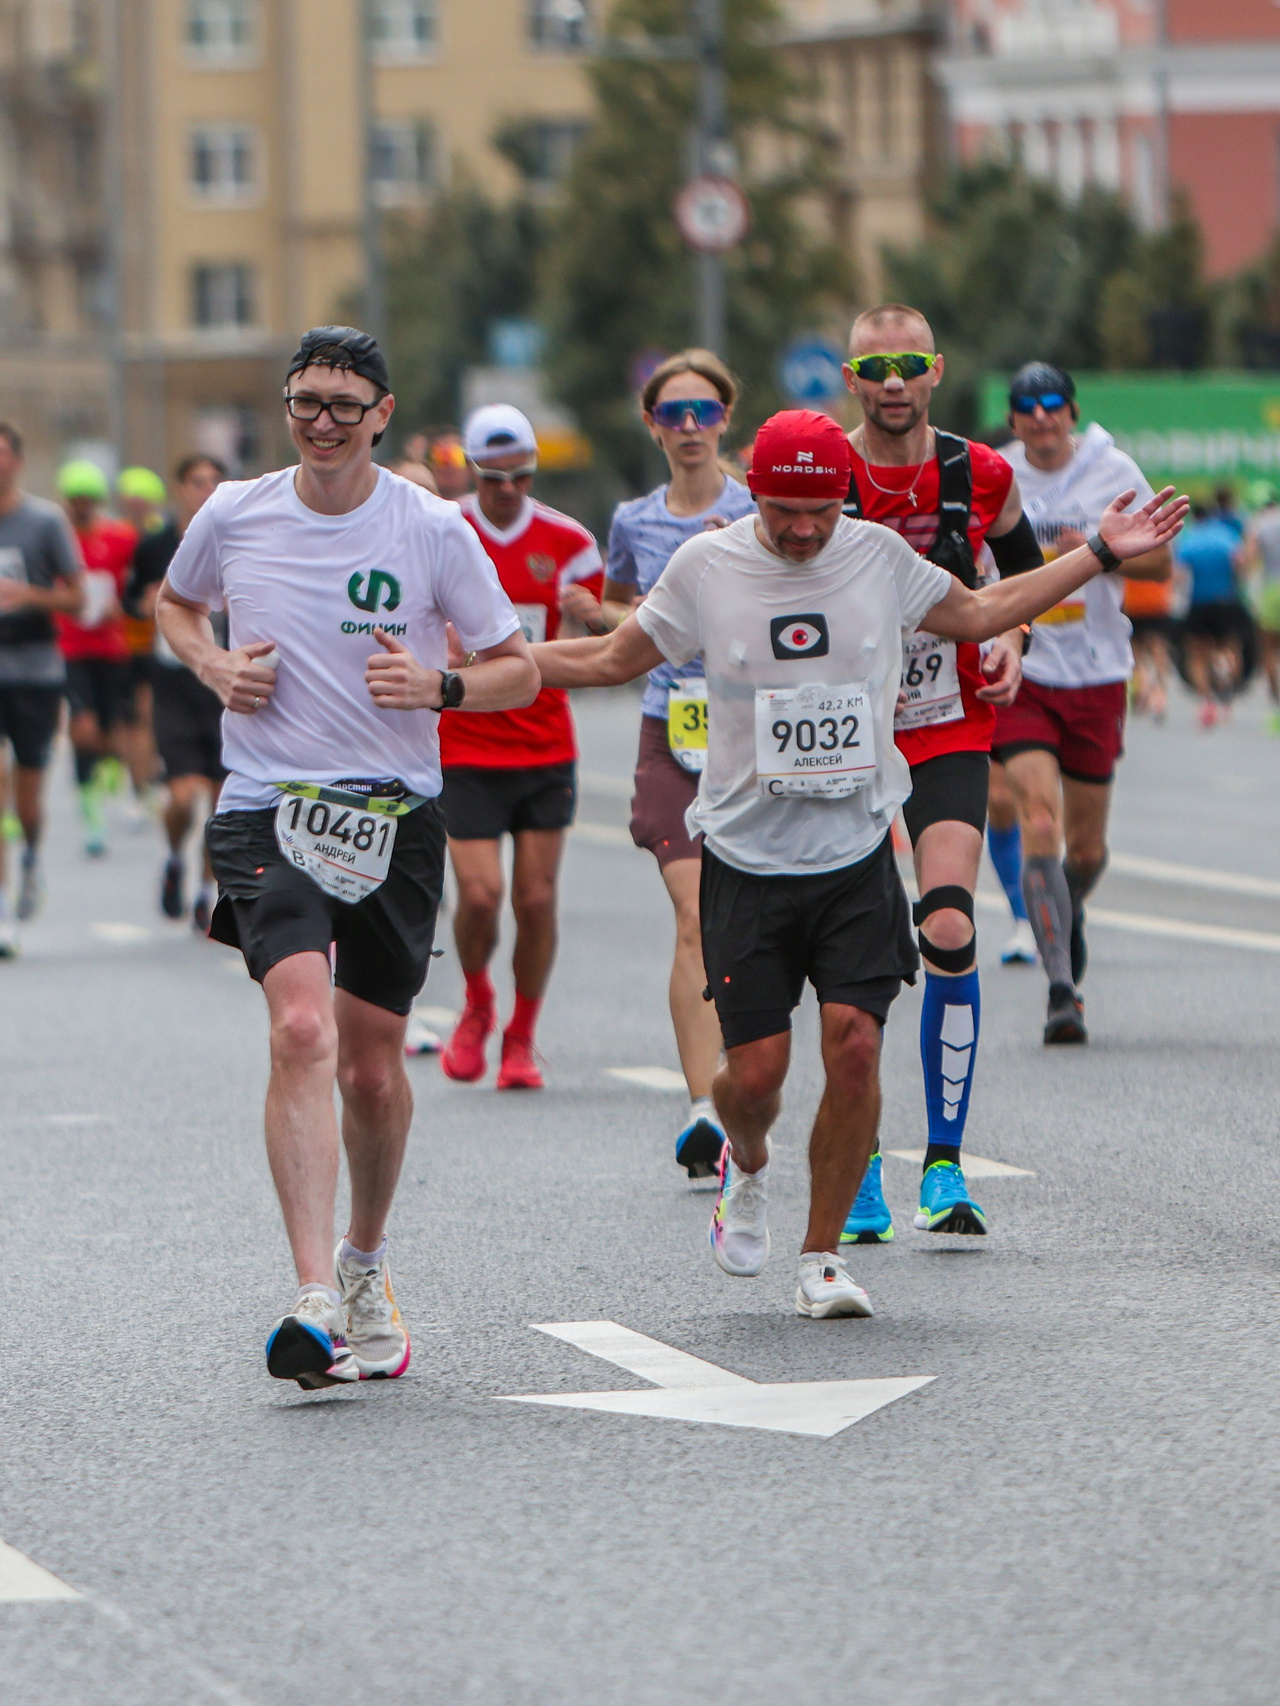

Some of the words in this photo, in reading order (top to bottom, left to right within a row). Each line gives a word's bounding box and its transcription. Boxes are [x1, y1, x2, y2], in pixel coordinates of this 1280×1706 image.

[772, 465, 837, 475] NORDSKI
[900, 653, 943, 688] 69
[818, 699, 843, 711] 42,2
[847, 696, 863, 708] КМ
[772, 714, 860, 753] 9032
[794, 753, 843, 767] АЛЕКСЕЙ
[287, 796, 391, 857] 10481
[314, 842, 357, 865] АНДРЕЙ
